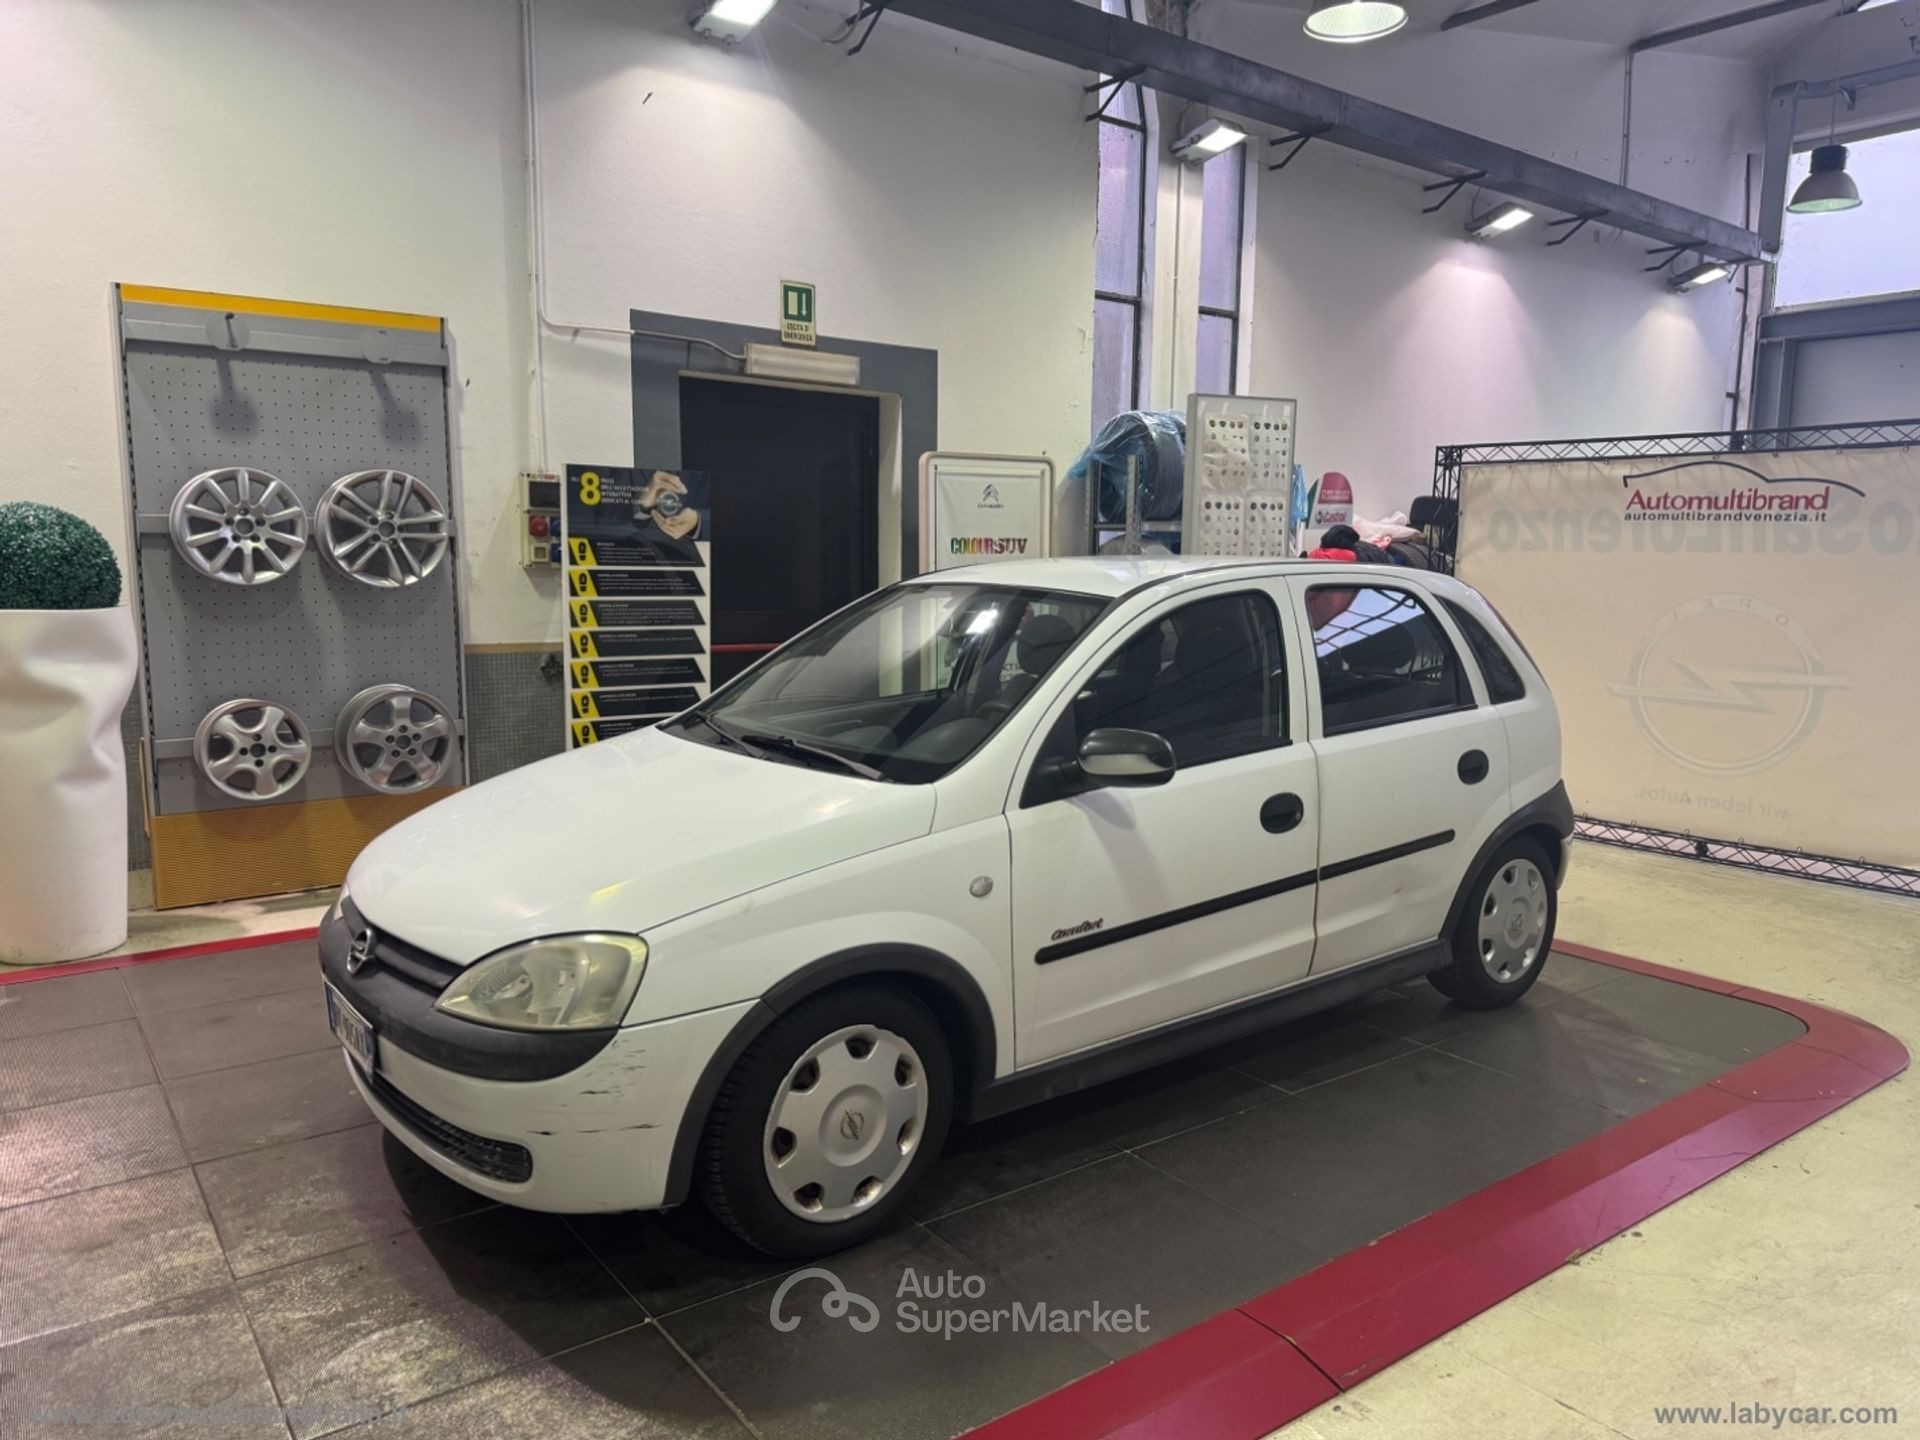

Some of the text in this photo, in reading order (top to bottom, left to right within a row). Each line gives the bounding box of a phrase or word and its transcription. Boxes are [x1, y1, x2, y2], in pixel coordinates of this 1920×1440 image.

[579, 471, 601, 506] 8
[1625, 486, 1830, 511] Automultibrand
[1624, 511, 1827, 523] automultibrandvenezia.it
[1051, 918, 1104, 941] Comfort
